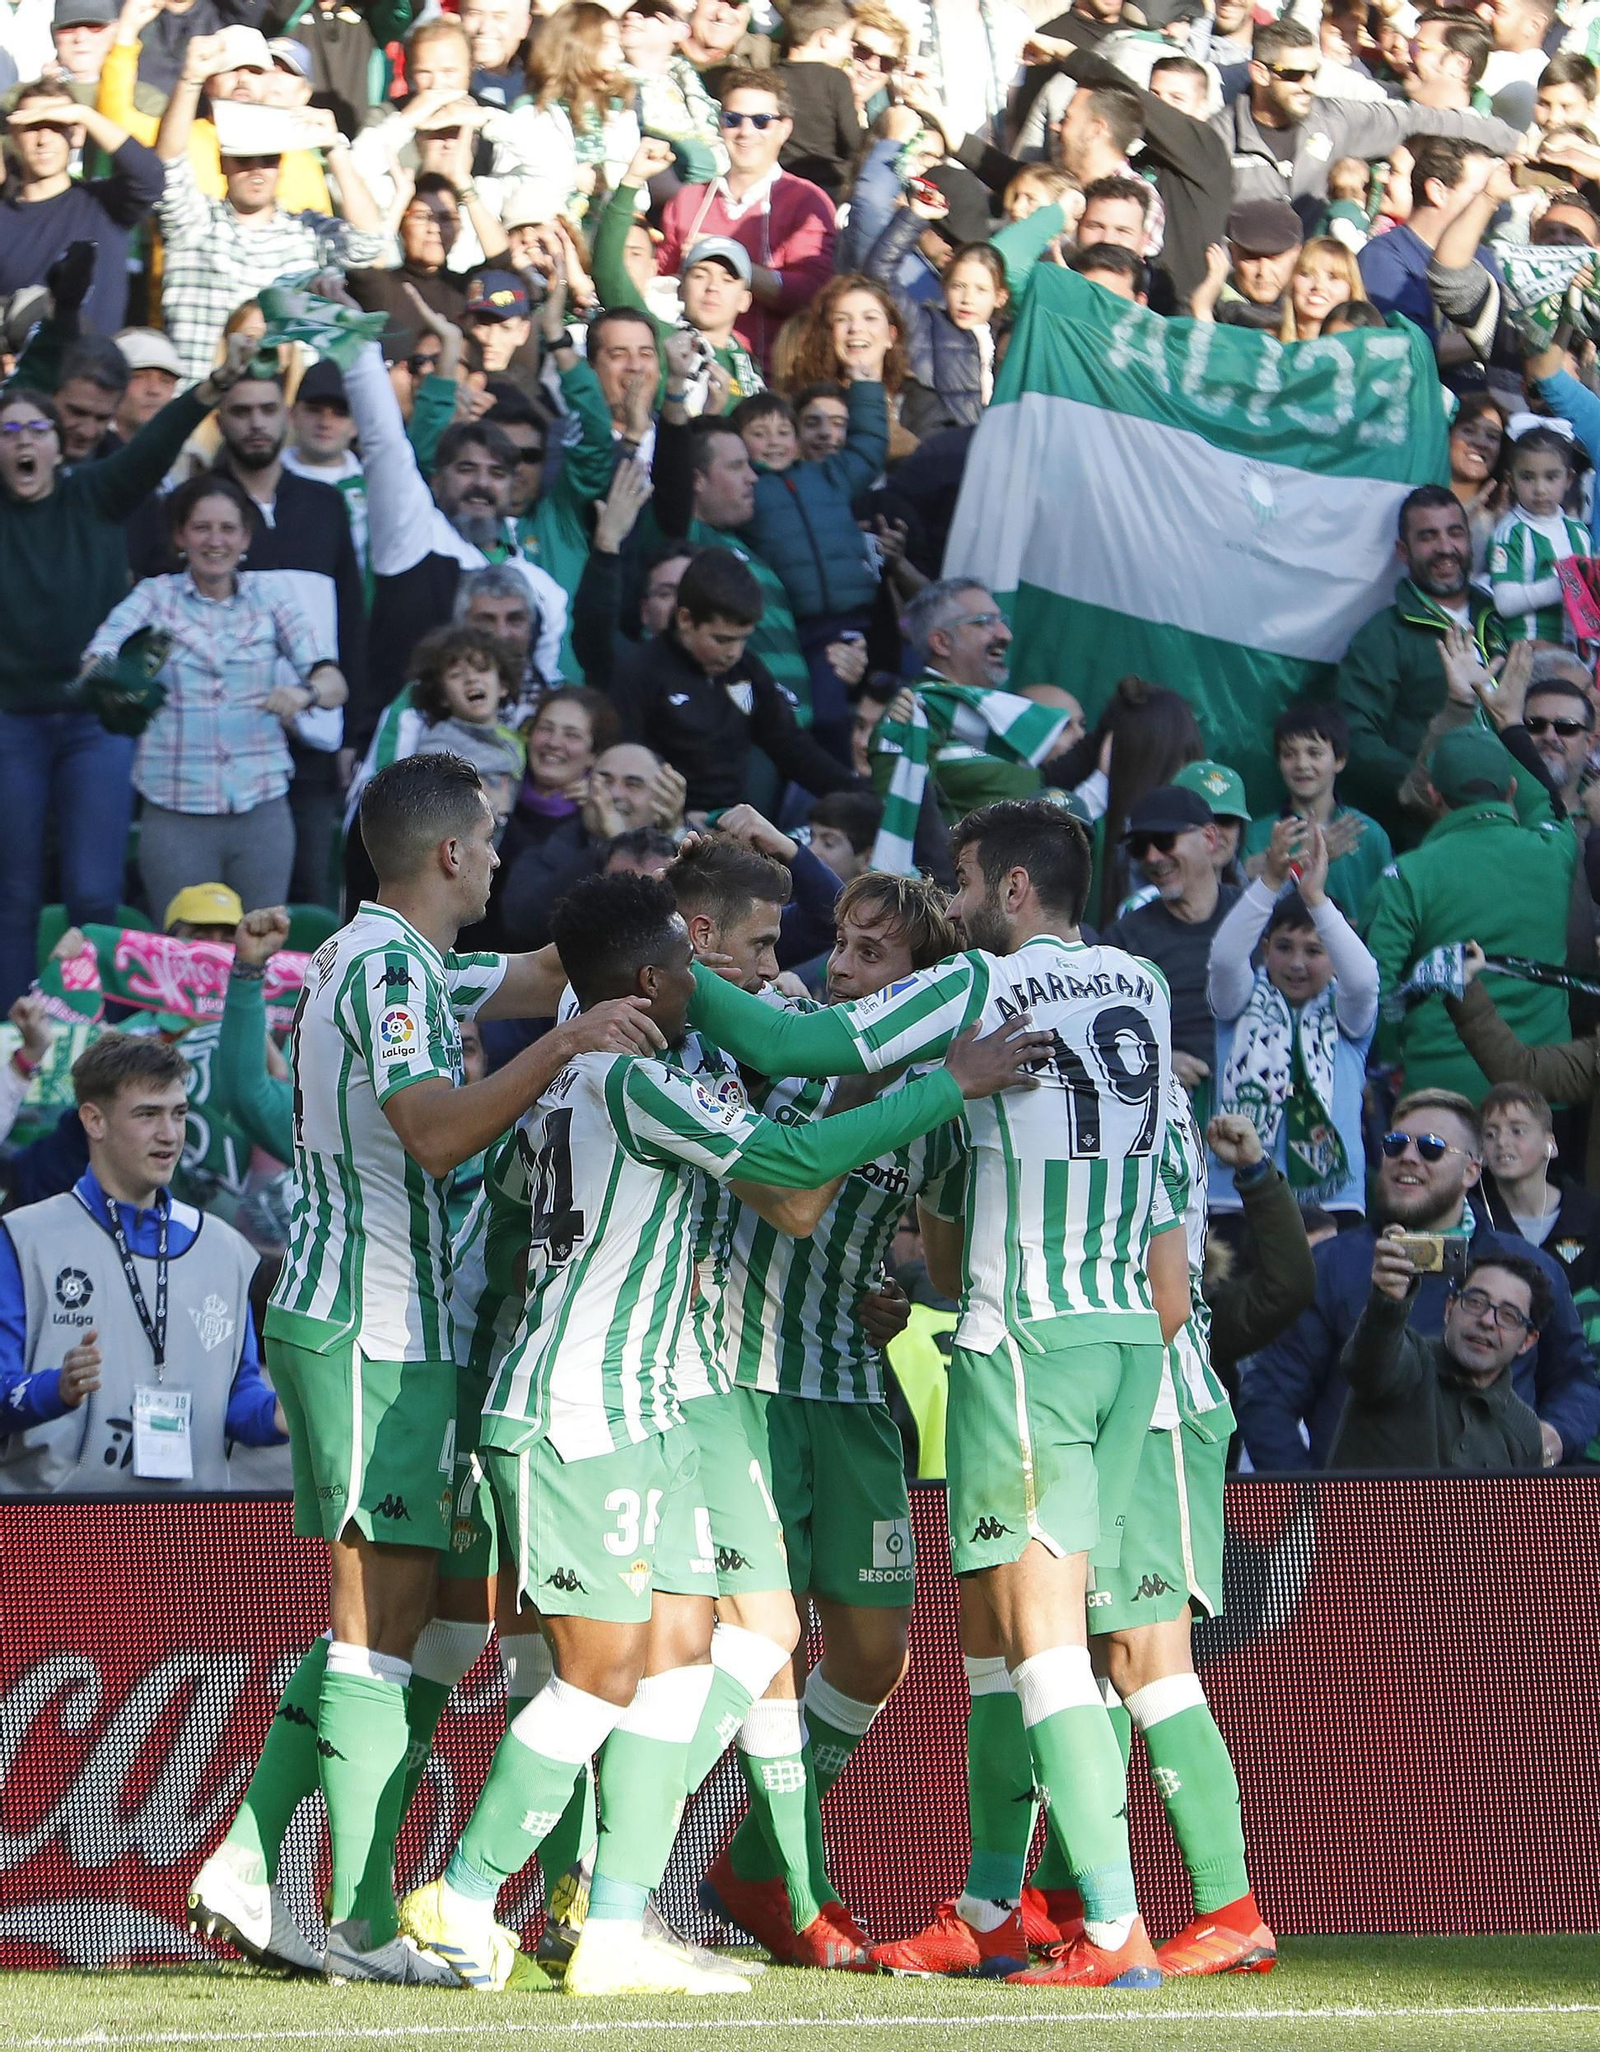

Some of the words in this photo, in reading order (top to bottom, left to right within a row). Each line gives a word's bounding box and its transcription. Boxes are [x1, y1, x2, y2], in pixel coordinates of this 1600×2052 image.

[382, 1046, 416, 1059] LaLiga
[1022, 1004, 1160, 1160] 19
[53, 1312, 94, 1328] LaLiga
[858, 1568, 915, 1583] BESOCC
